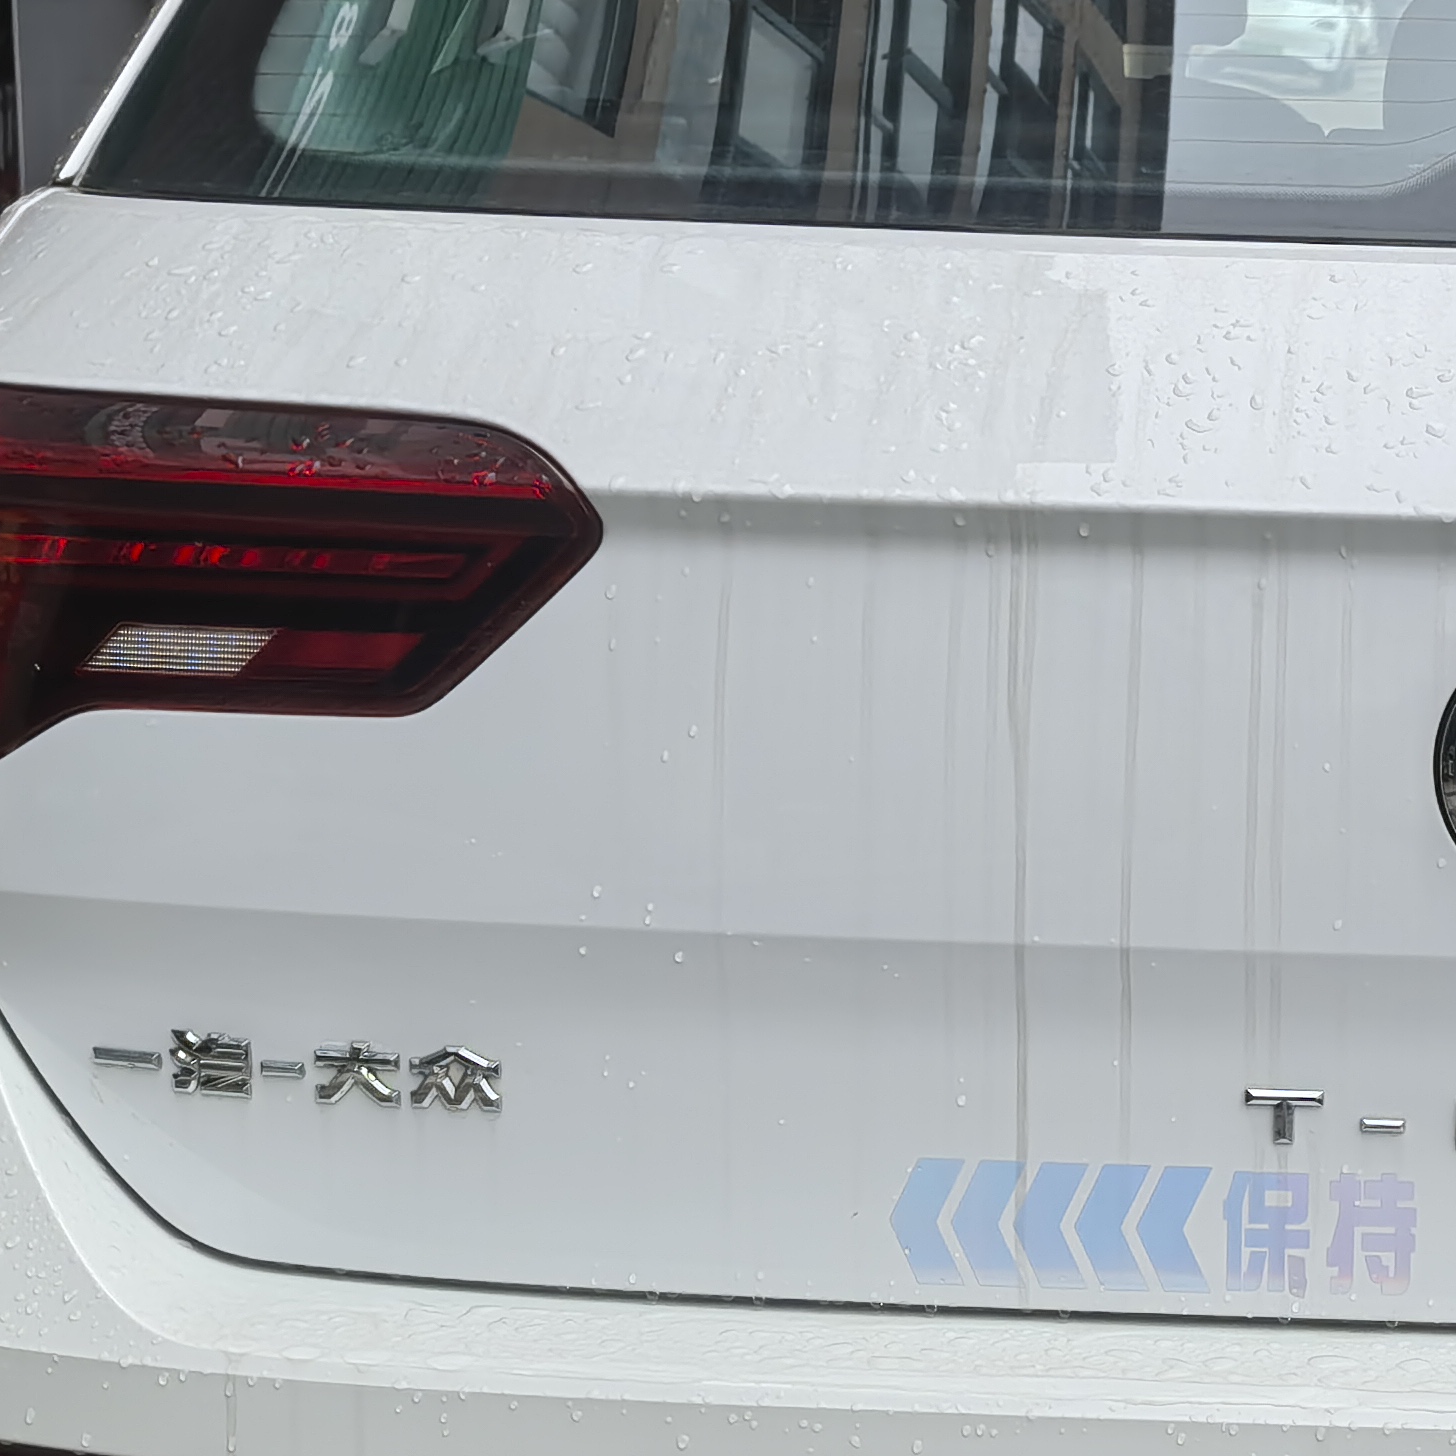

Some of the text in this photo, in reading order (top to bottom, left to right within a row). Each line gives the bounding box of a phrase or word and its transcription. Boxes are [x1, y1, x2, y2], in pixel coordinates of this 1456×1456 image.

[91, 1027, 504, 1113] 一汽-大众
[1222, 1170, 1417, 1297] 保持
